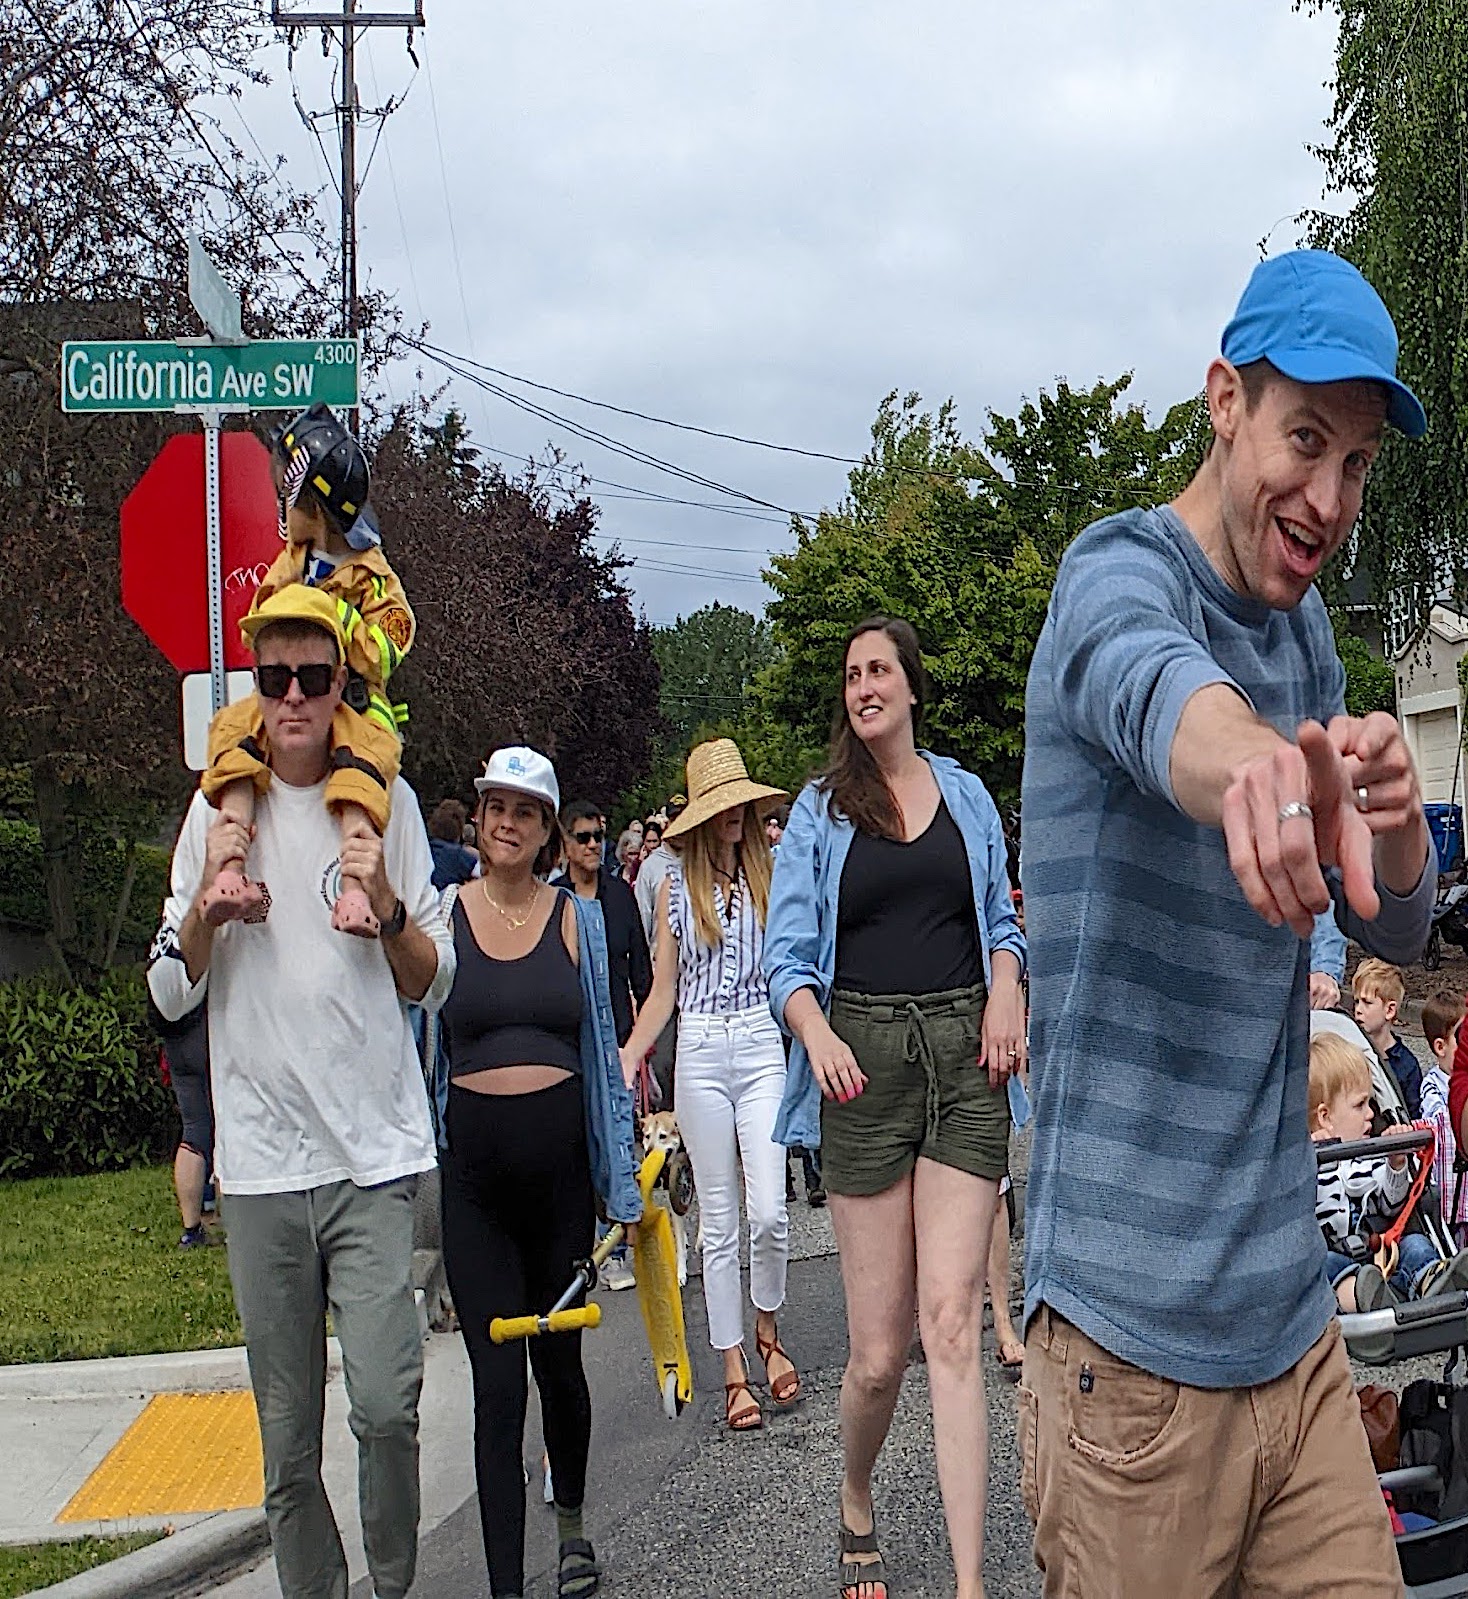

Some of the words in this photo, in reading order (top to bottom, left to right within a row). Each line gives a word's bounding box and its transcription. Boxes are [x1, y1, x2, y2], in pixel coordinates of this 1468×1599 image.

[314, 344, 356, 365] 4300
[68, 350, 213, 401] California
[220, 365, 267, 399] Ave
[274, 363, 315, 398] SW
